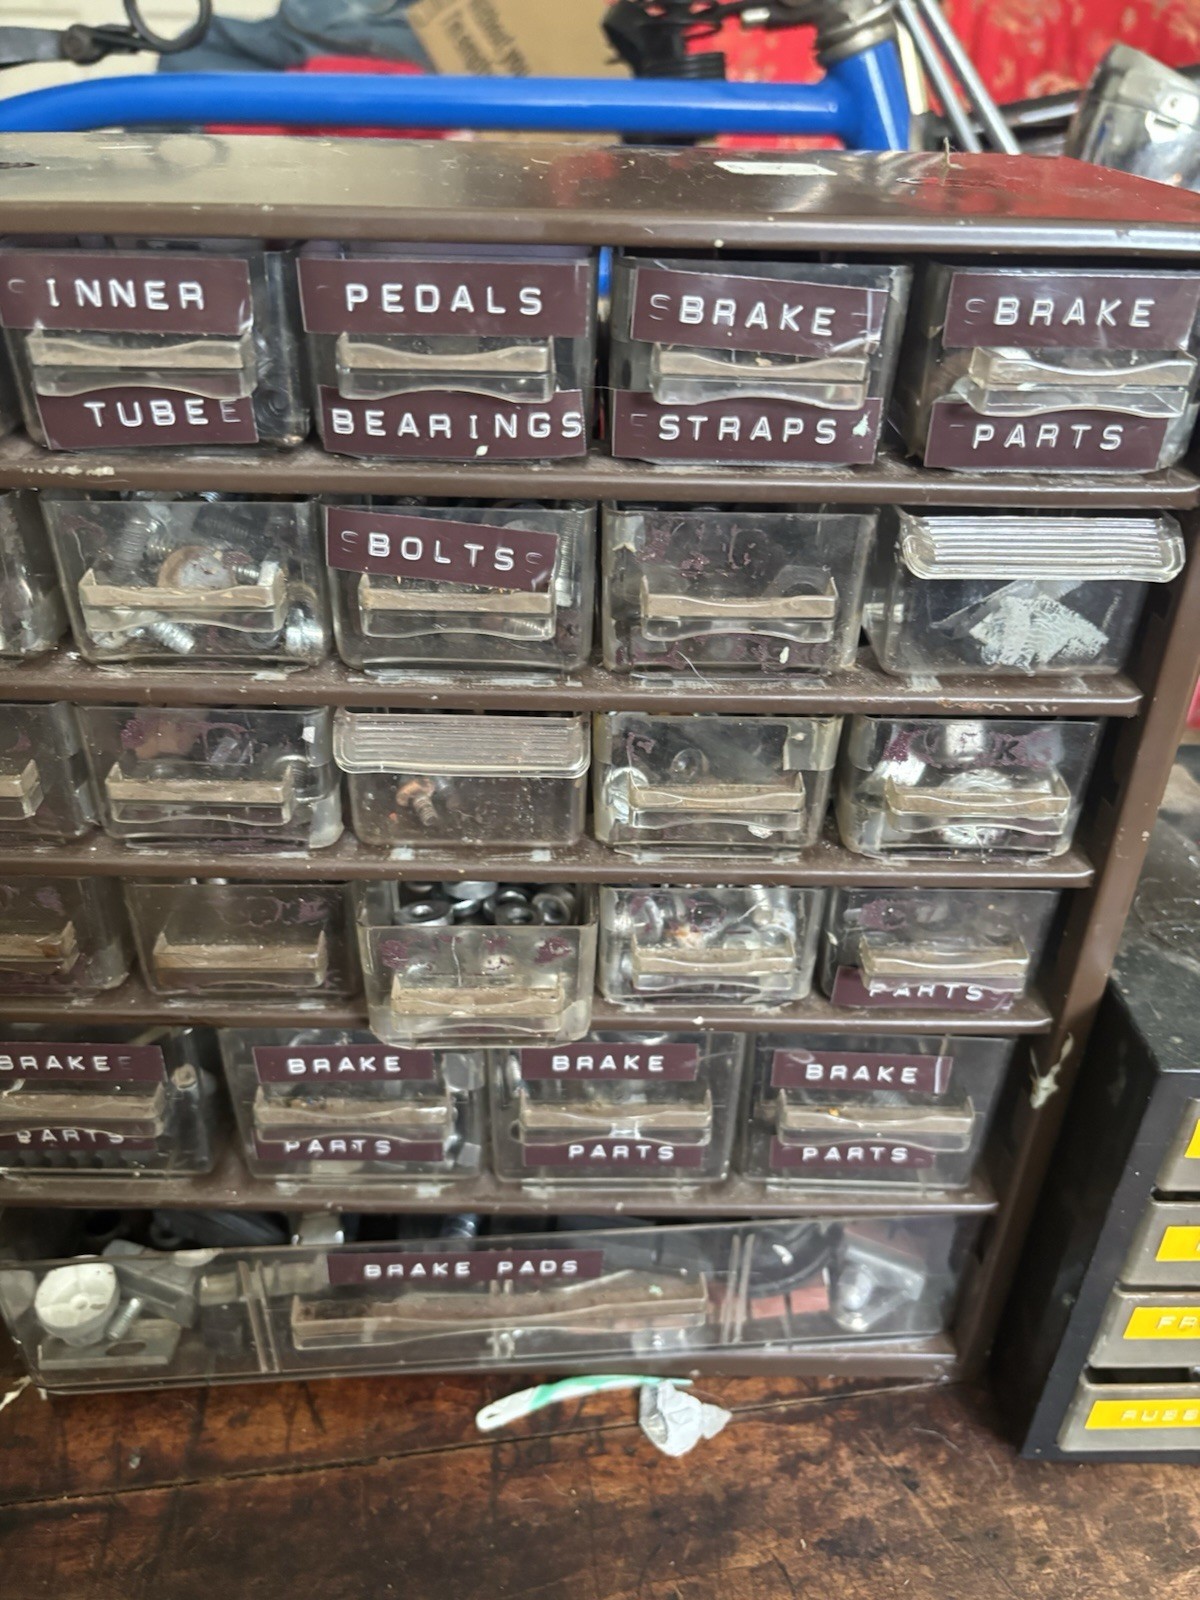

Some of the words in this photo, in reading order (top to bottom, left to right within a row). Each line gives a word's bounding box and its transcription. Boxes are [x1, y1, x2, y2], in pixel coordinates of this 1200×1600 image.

[48, 277, 205, 311] INNER
[345, 282, 544, 316] PEDALS
[678, 295, 836, 336] BRAKE
[992, 297, 1156, 329] BRAKE
[331, 409, 583, 440] BEARINGS
[657, 413, 838, 445] STRAPS
[972, 422, 1125, 451] PARTS
[367, 531, 516, 572] BOLTS
[287, 1055, 402, 1076] BRAKE
[551, 1053, 665, 1073] BRAKE
[805, 1062, 918, 1084] BRAKE
[284, 1138, 392, 1155] PARTS
[568, 1144, 675, 1161] PARTS
[802, 1146, 909, 1163] PARTS
[363, 1261, 471, 1279] BRAKE
[497, 1259, 578, 1275] PADS
